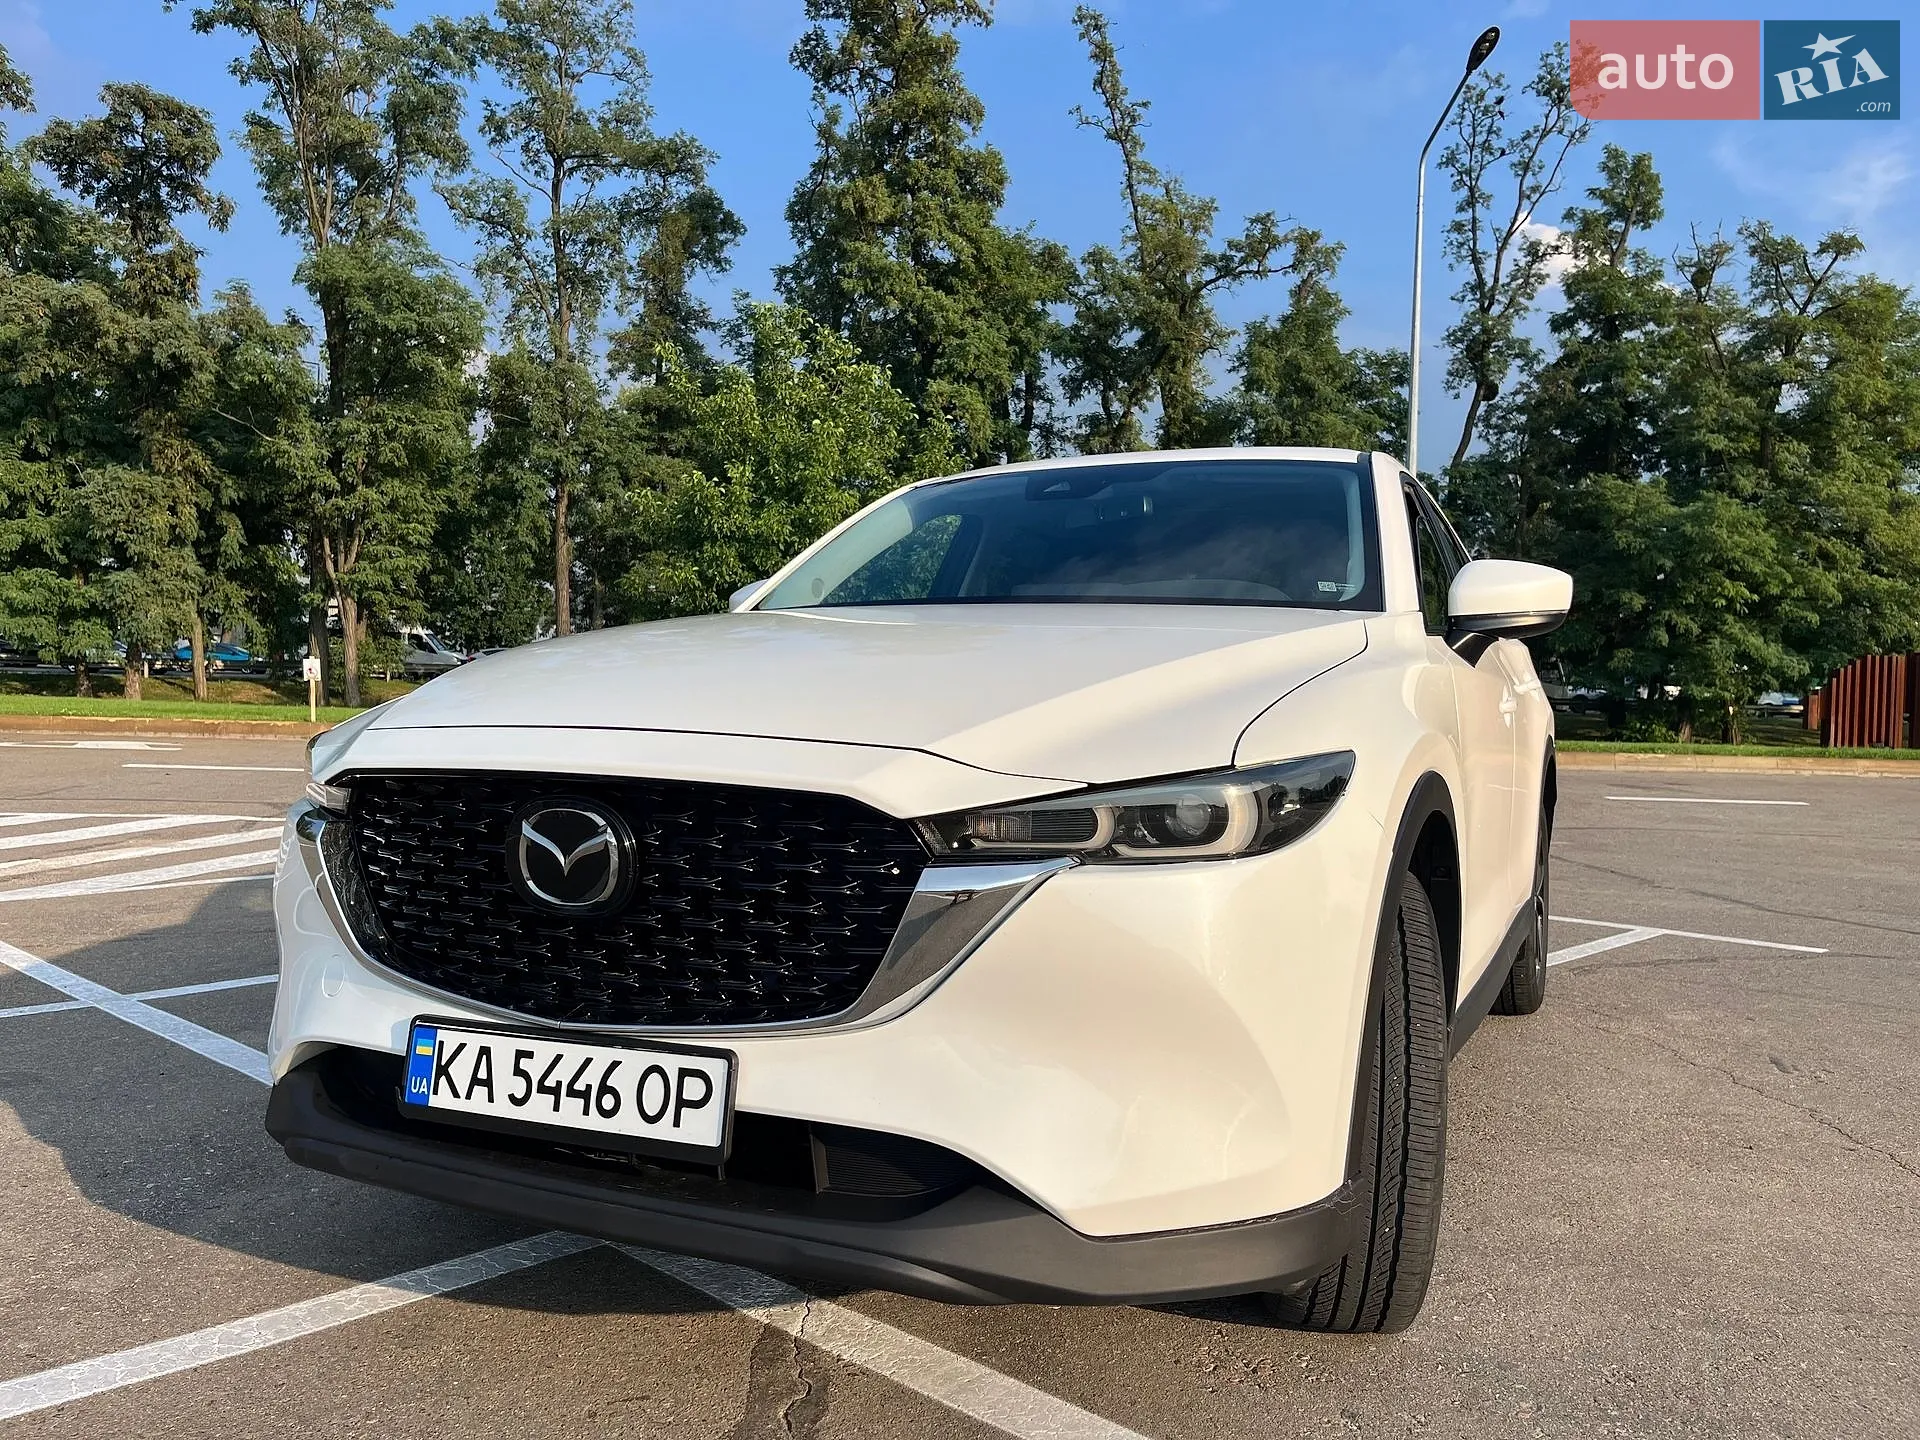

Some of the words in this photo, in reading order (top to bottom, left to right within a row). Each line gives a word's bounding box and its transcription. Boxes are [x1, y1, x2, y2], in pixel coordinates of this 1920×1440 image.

[411, 1077, 428, 1096] UA
[432, 1040, 495, 1104] KA
[508, 1049, 622, 1119] 5446
[636, 1064, 714, 1129] OP
